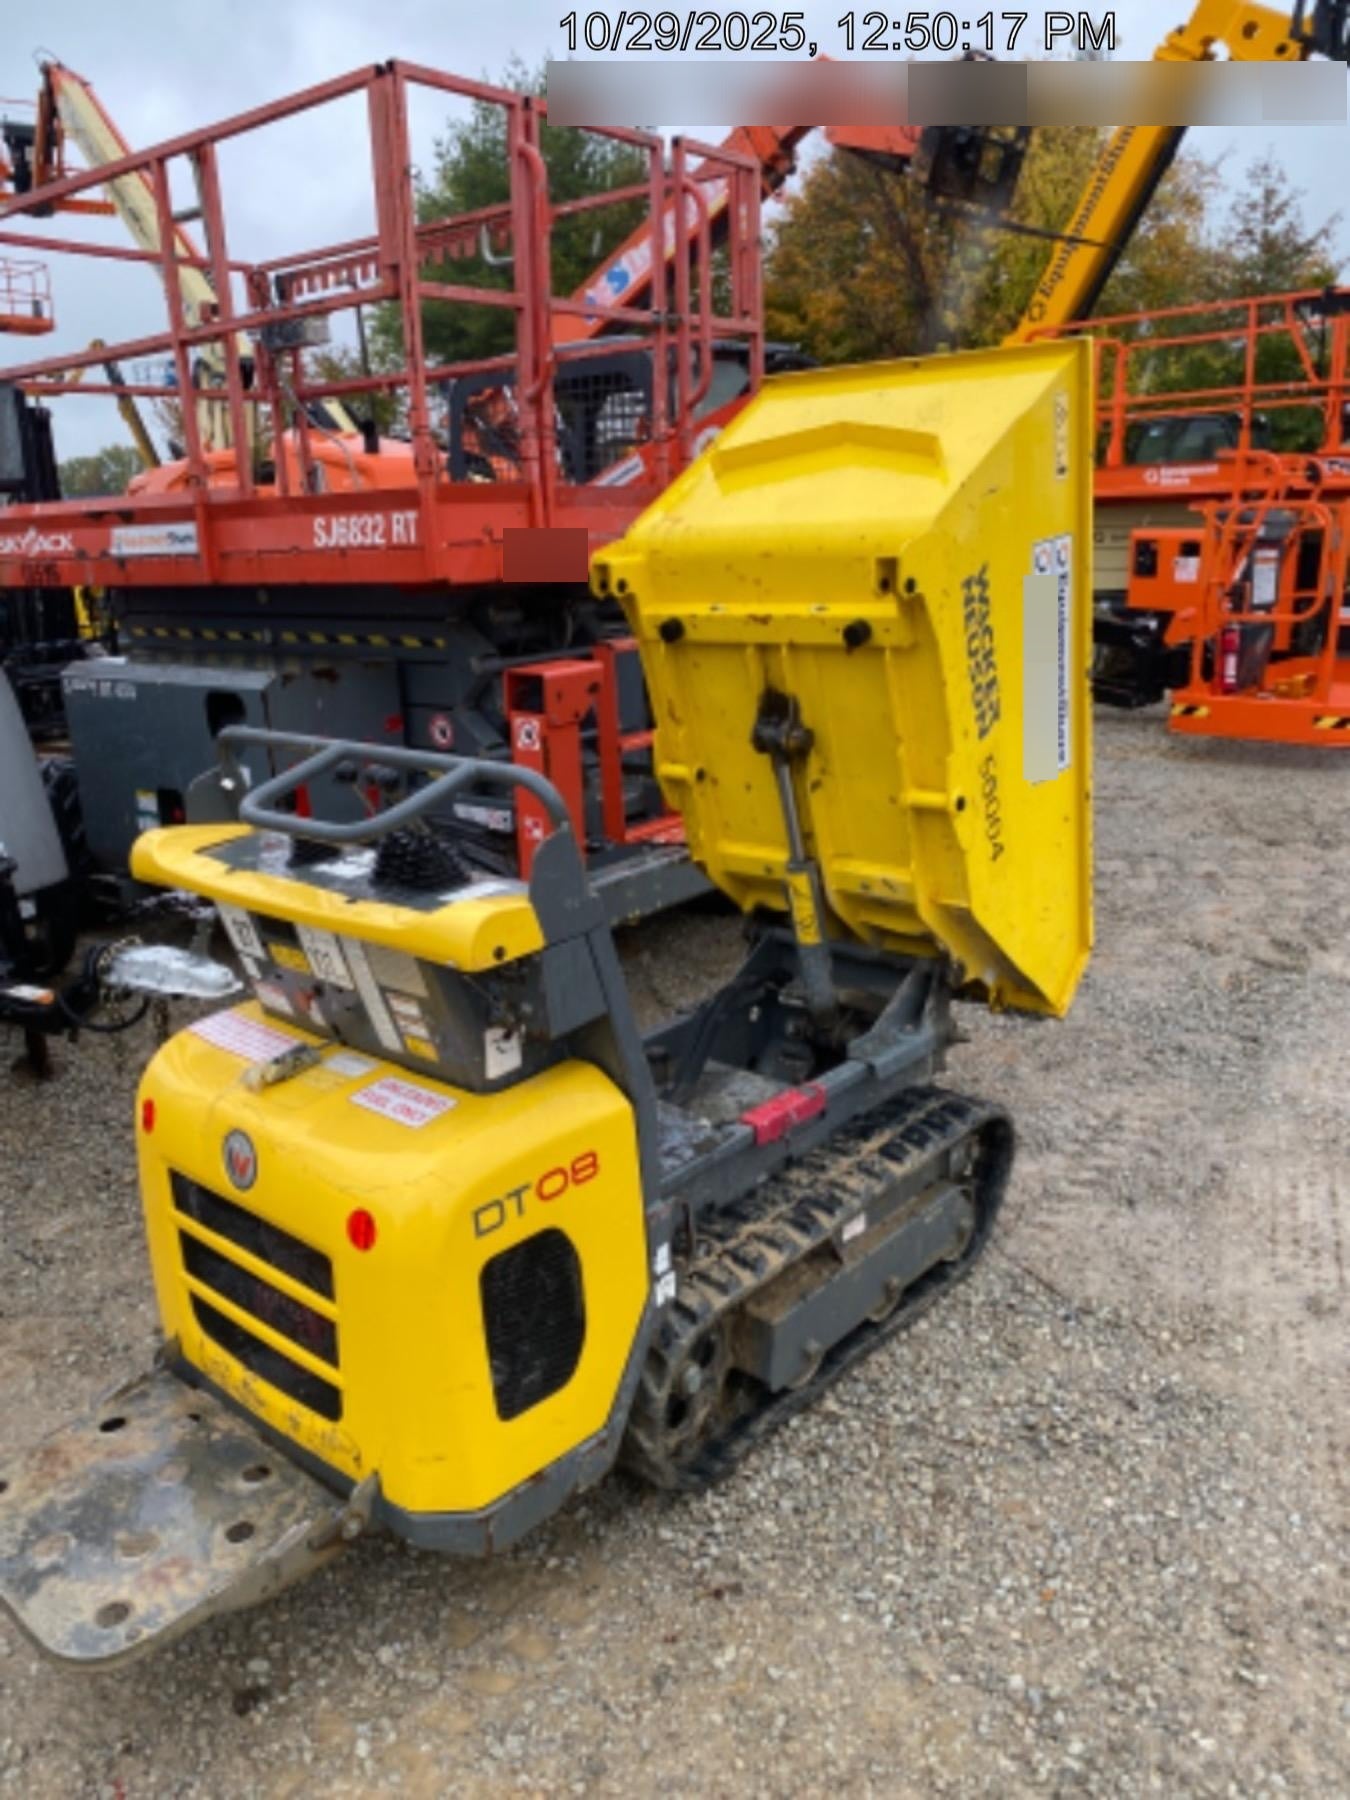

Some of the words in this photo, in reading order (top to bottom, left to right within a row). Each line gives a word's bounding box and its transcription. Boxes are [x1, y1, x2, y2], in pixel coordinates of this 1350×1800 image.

[313, 512, 387, 548] SJ6832
[391, 509, 418, 544] RT
[976, 561, 1001, 722] WACKER
[472, 1150, 599, 1238] DT08
